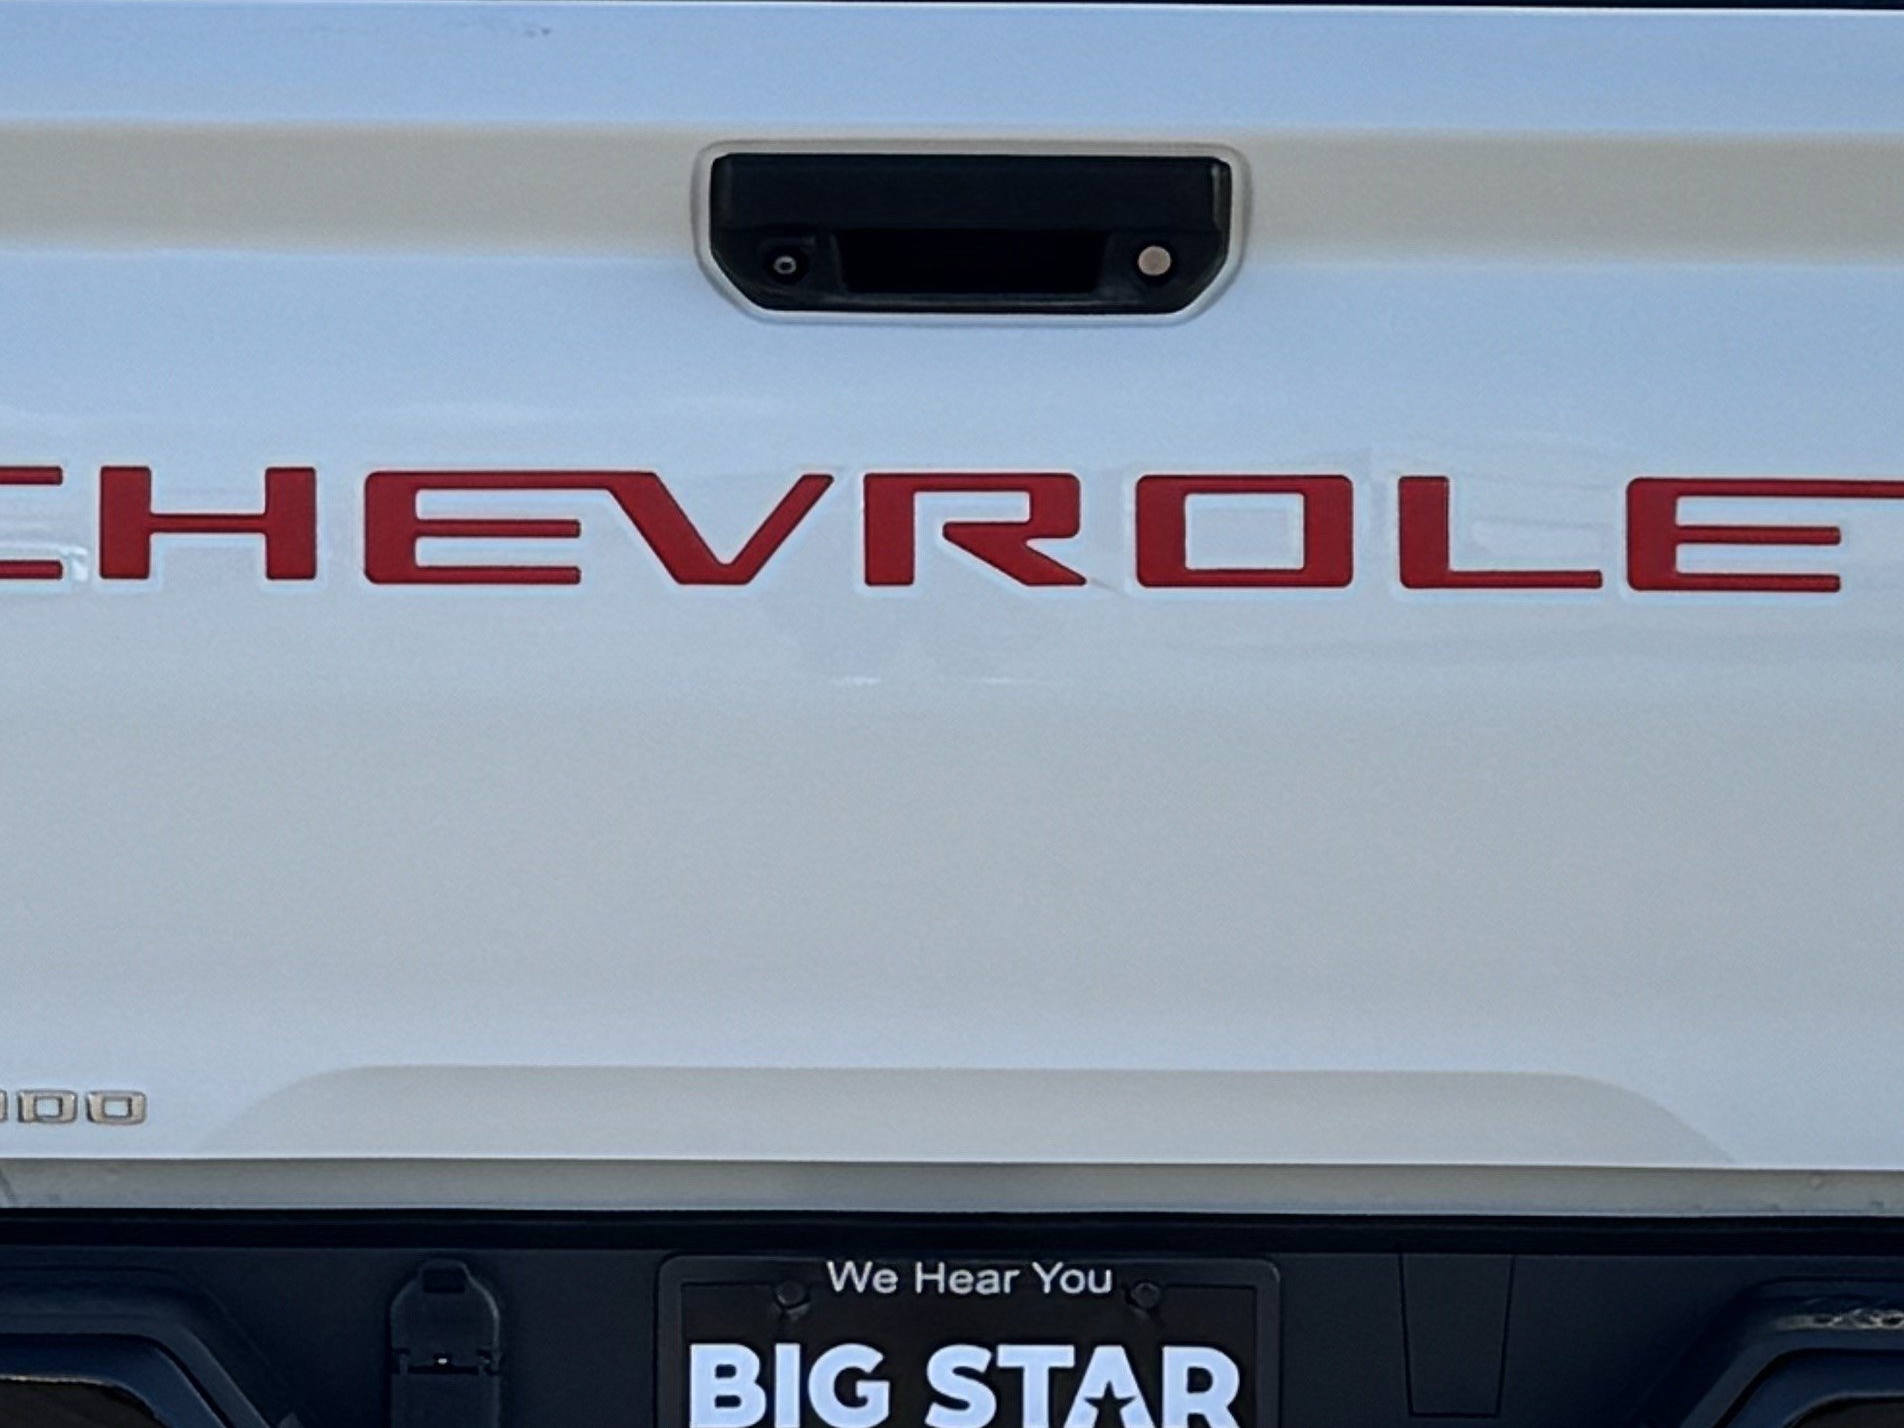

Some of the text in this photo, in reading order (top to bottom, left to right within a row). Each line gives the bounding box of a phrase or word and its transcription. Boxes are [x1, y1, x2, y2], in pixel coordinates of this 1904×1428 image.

[826, 1260, 1113, 1295] We Hear You
